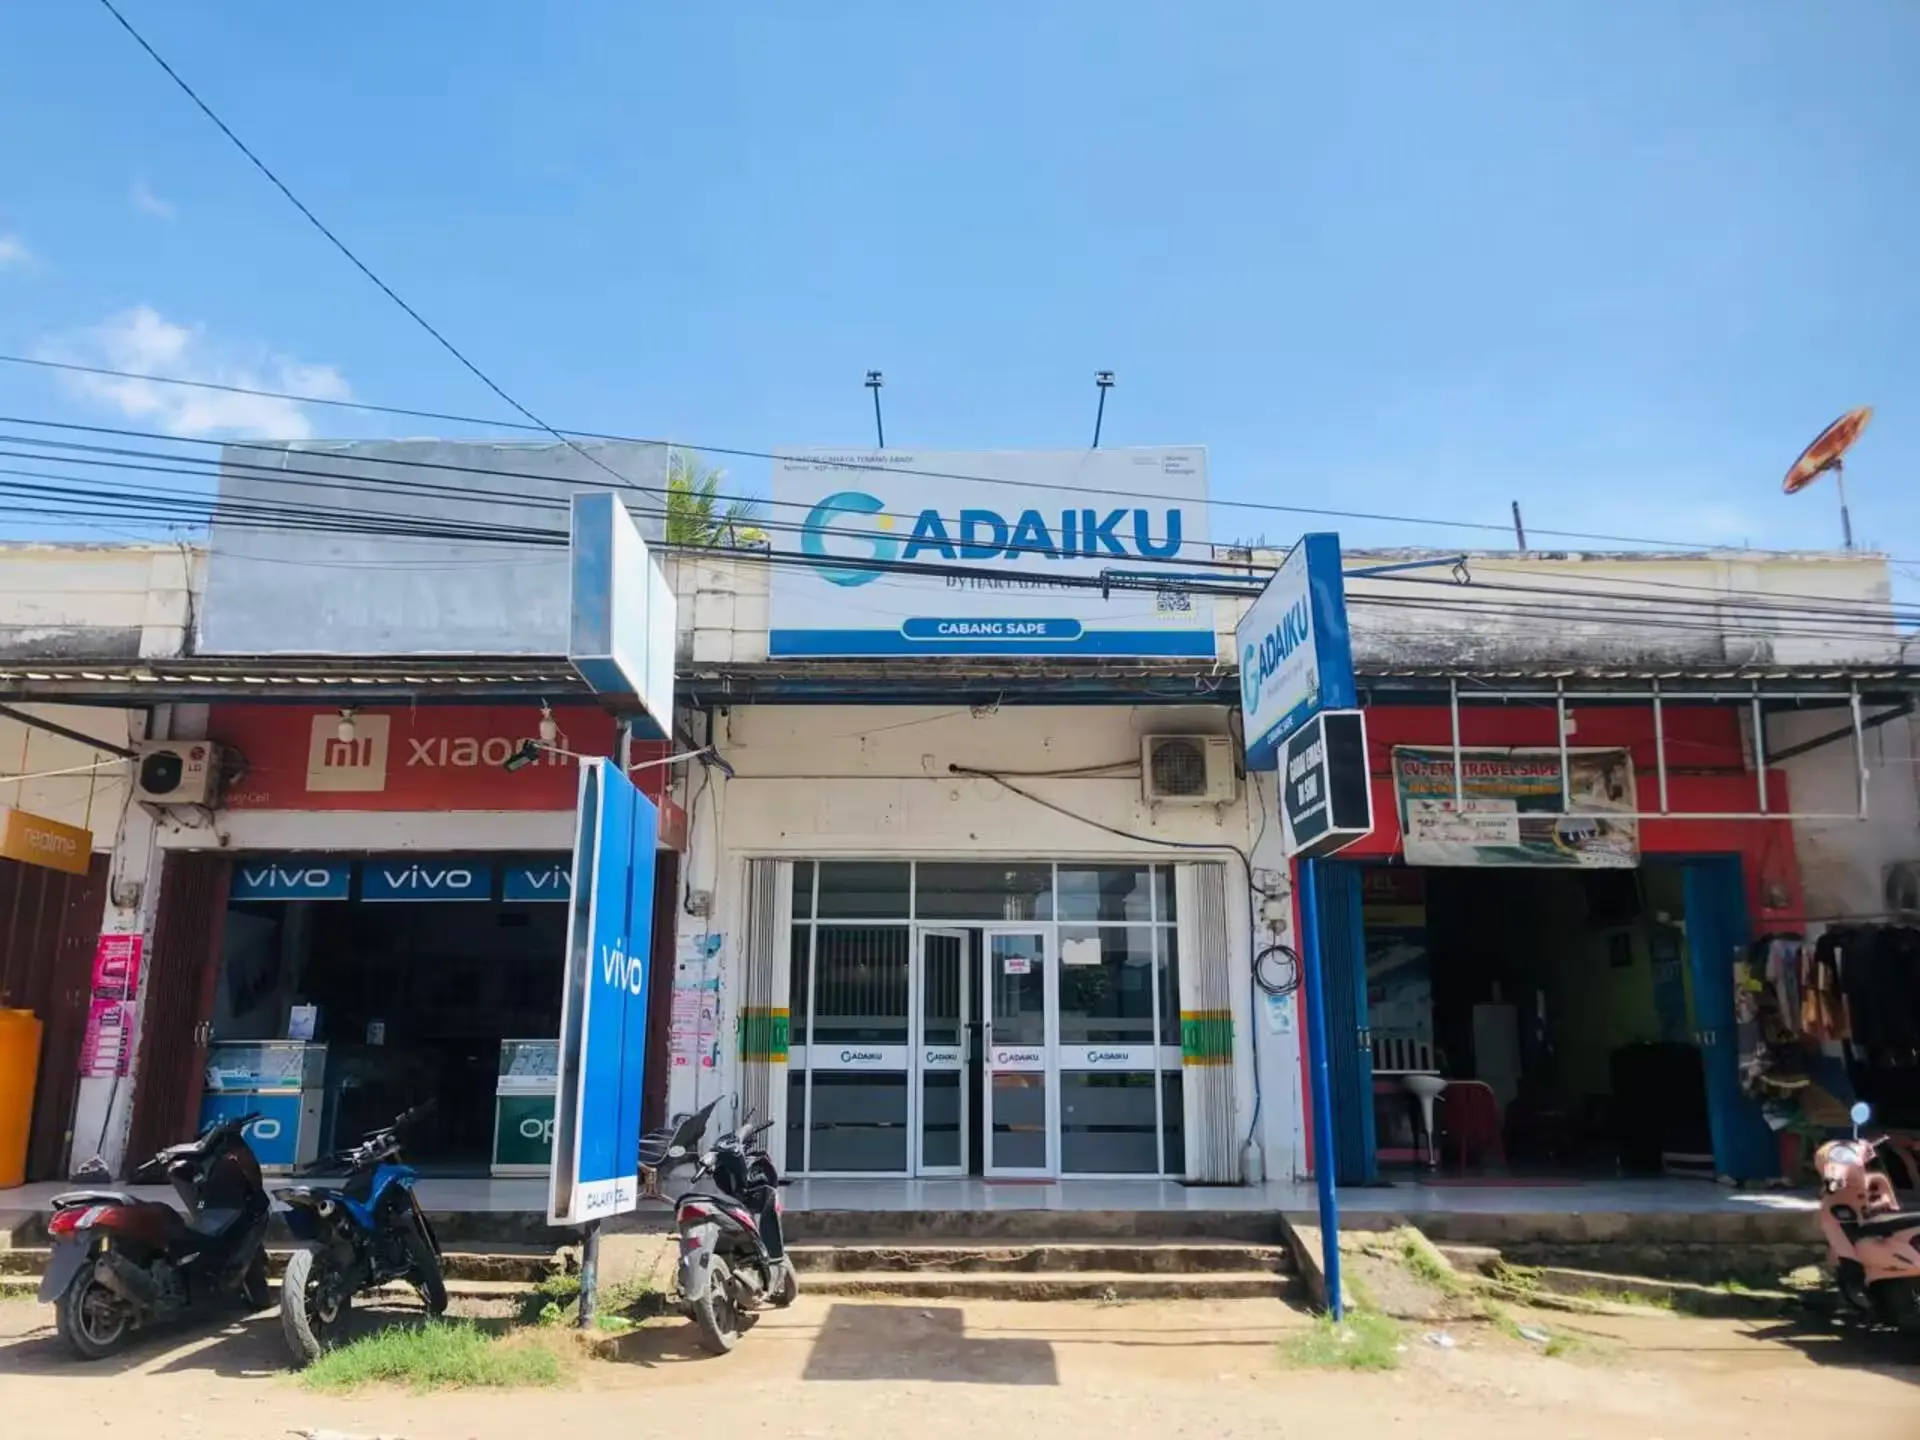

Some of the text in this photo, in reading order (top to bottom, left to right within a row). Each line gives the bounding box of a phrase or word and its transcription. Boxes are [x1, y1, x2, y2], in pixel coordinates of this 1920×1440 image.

[938, 623, 1046, 634] CABANG SAPE
[1243, 594, 1309, 715] GADAIKU
[243, 864, 331, 887] vivo
[383, 864, 473, 888] vivo
[525, 864, 573, 888] viv
[602, 936, 642, 996] vivo
[520, 1118, 556, 1144] op
